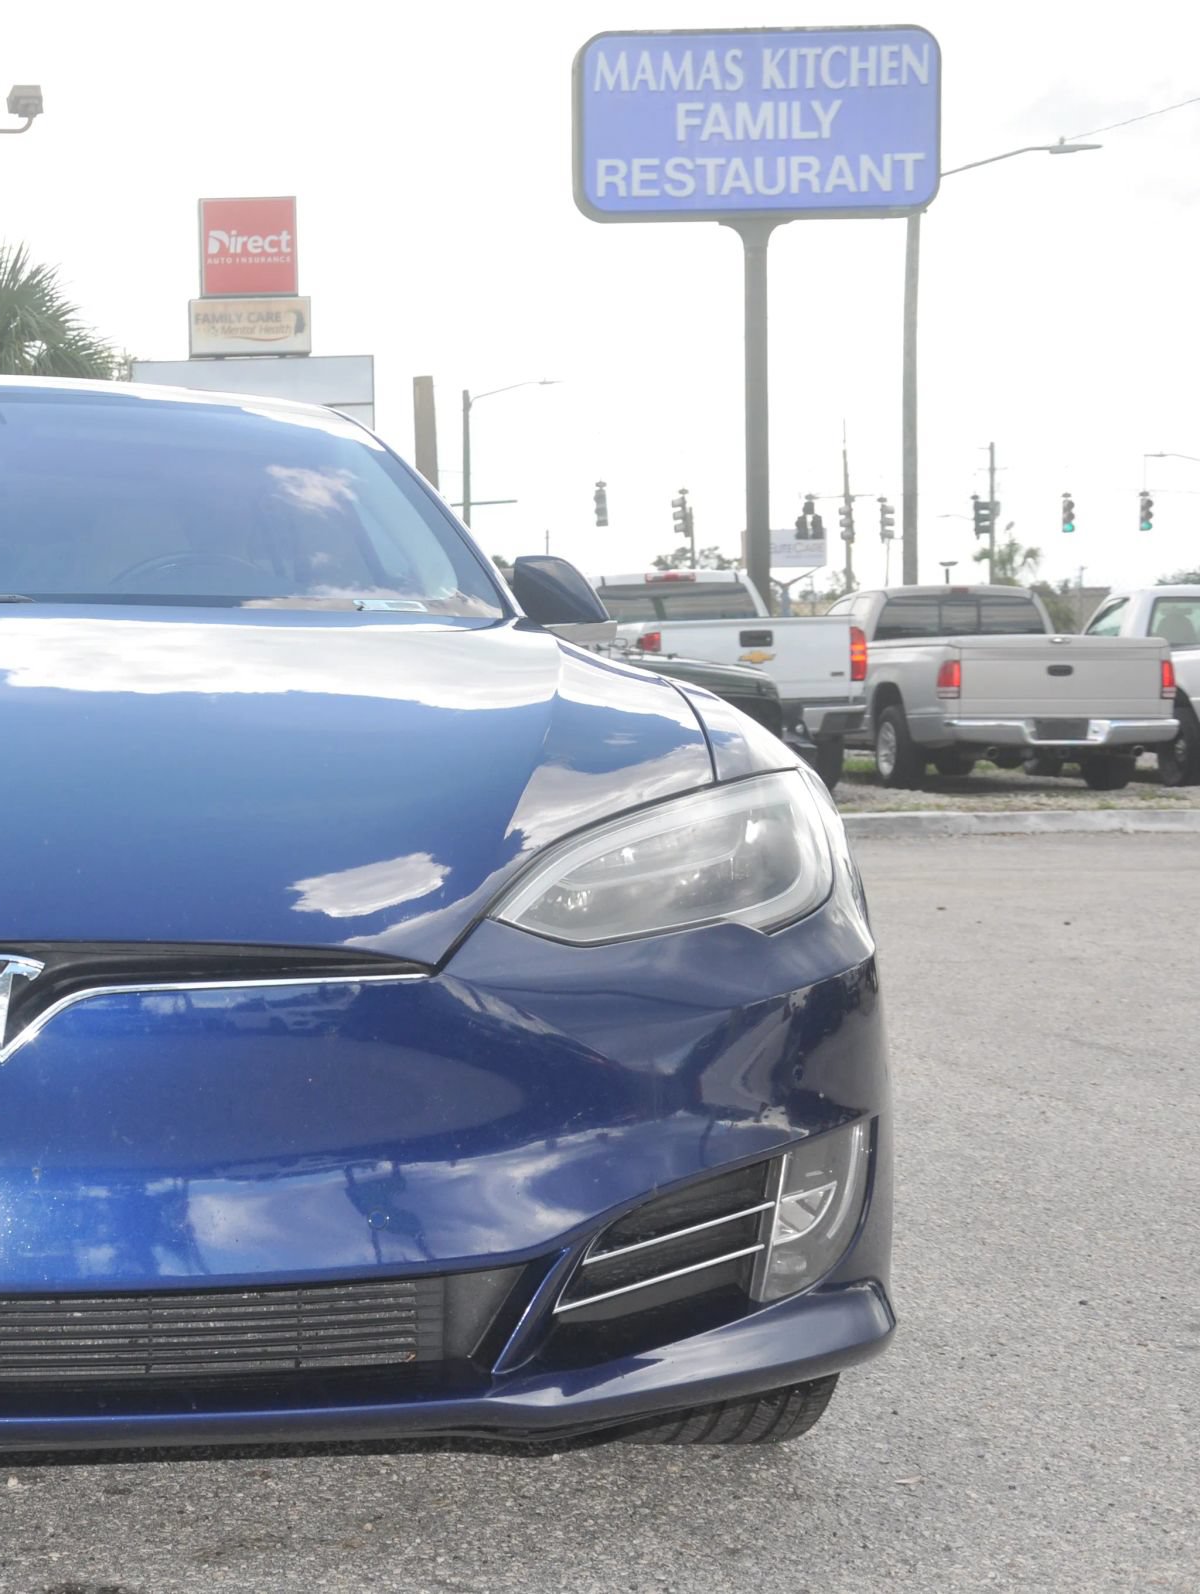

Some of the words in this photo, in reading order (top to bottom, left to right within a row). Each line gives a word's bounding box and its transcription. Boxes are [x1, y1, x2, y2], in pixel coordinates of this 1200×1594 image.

[593, 49, 744, 92] MAMAS
[761, 44, 930, 90] KITCHEN
[676, 99, 843, 141] FAMILY
[596, 152, 926, 198] RESTAURANT
[207, 229, 291, 254] Direct
[207, 256, 233, 265] AUTO
[236, 255, 291, 264] INSURANCE
[195, 312, 243, 325] FAMILY
[247, 311, 282, 323] CARE
